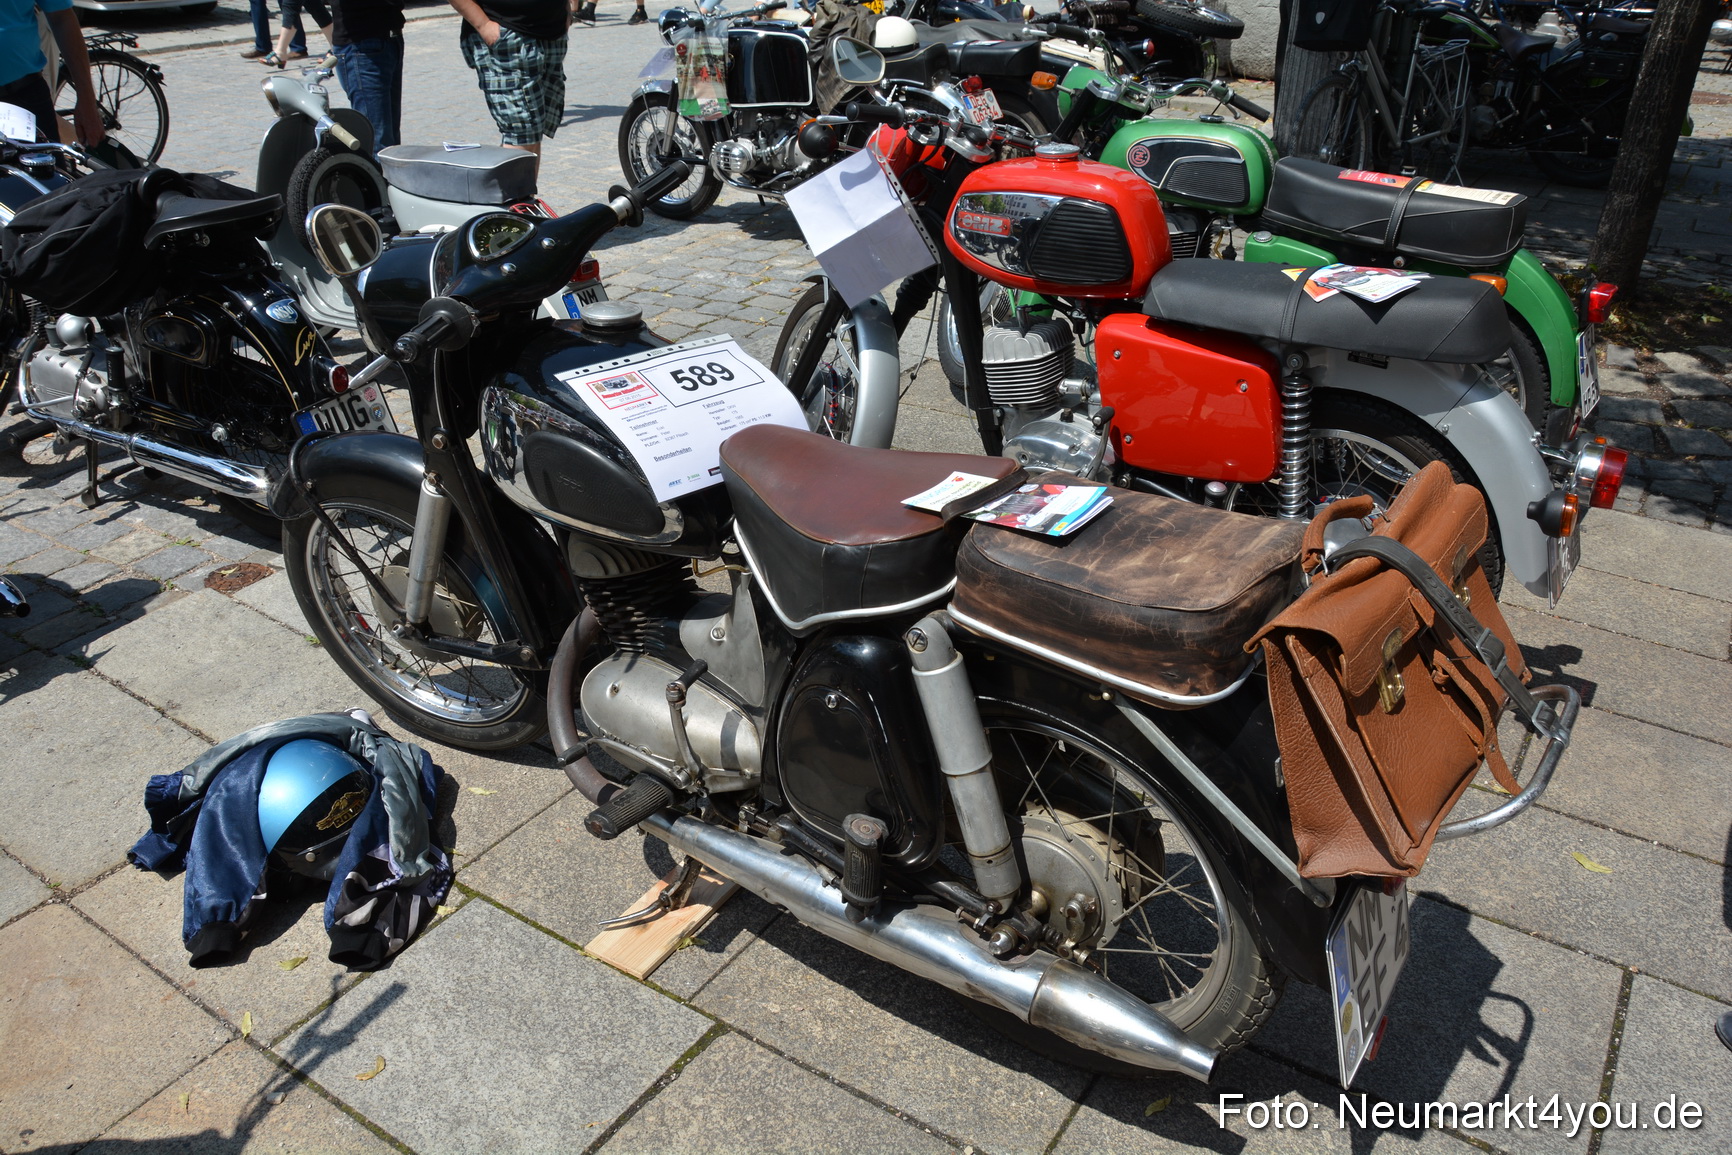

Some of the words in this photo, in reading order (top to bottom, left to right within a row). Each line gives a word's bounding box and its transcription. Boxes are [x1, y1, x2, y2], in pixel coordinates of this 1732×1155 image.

[577, 288, 599, 307] NM
[272, 304, 295, 319] NSU
[669, 362, 735, 392] 589
[313, 394, 371, 433] WUG
[702, 399, 725, 409] Fahrzeug
[653, 446, 693, 463] Besonderheiten
[1349, 890, 1384, 982] NM
[1356, 933, 1388, 1044] EF
